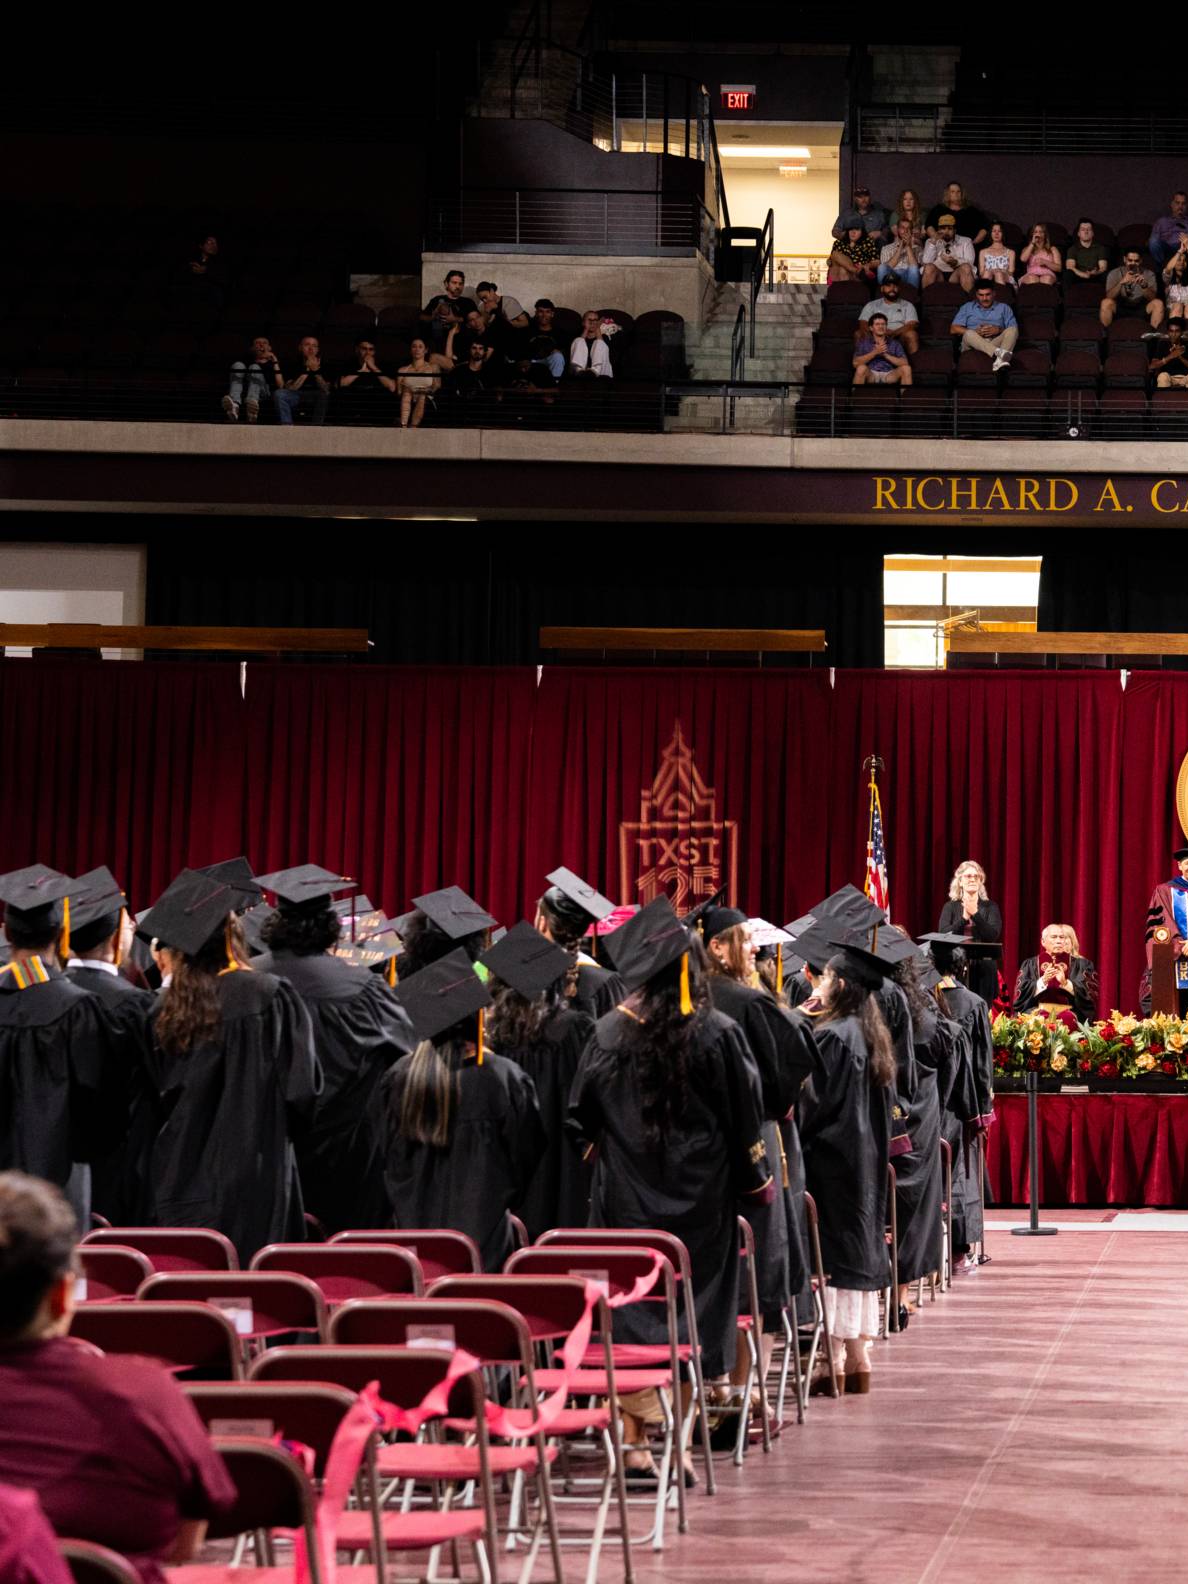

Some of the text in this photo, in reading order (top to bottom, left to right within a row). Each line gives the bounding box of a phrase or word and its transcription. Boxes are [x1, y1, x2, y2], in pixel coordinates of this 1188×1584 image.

[728, 93, 749, 109] EXIT
[872, 478, 1078, 510] RICHARD
[1094, 480, 1133, 511] A.
